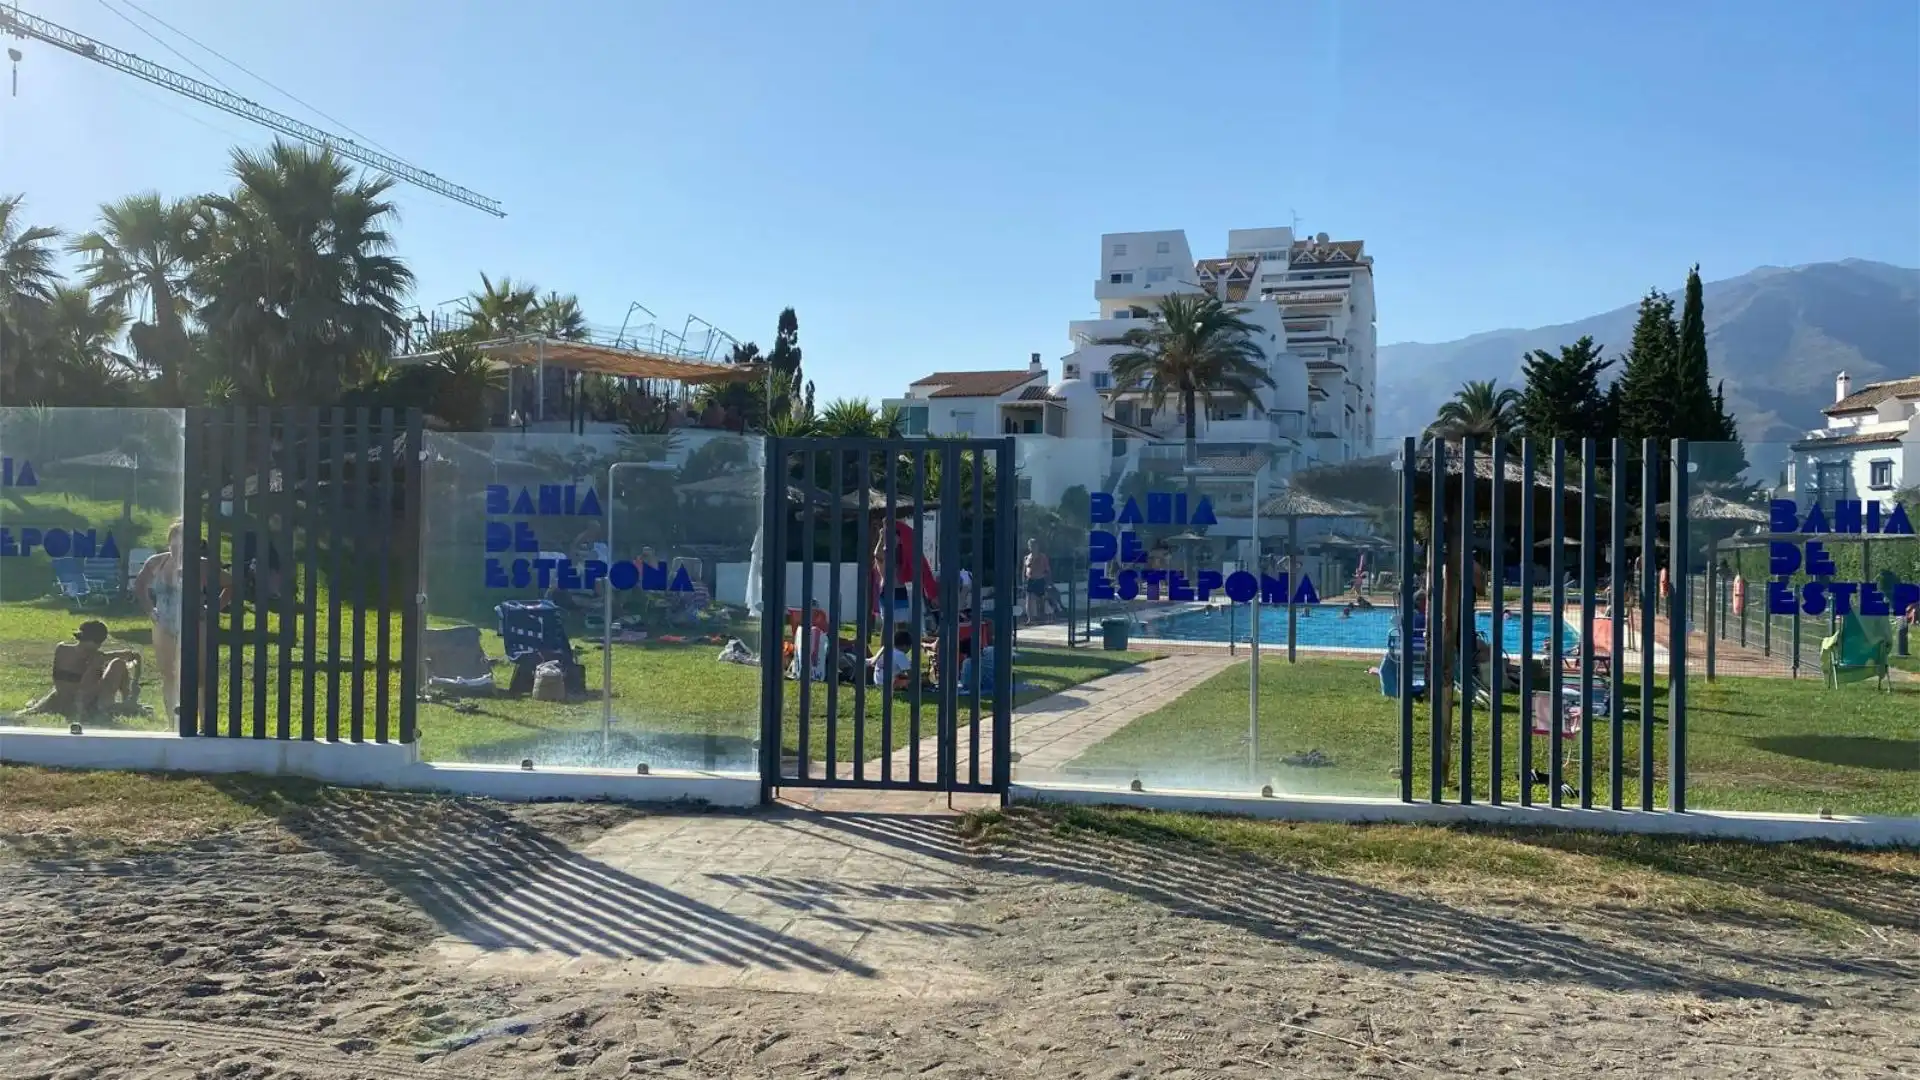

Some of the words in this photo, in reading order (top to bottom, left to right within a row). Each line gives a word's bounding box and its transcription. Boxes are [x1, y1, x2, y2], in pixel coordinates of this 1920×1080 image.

[486, 484, 602, 515] BAHIA
[1090, 492, 1218, 525] BAHIA
[1770, 499, 1915, 534] BAHIA
[0, 527, 120, 558] EPONA
[486, 521, 539, 553] DE
[1089, 530, 1148, 563] DE
[1770, 541, 1836, 575] DE
[486, 558, 695, 592] ESTEPONA
[1088, 568, 1320, 604] ESTEPONA
[1769, 581, 1920, 616] ESTEP
